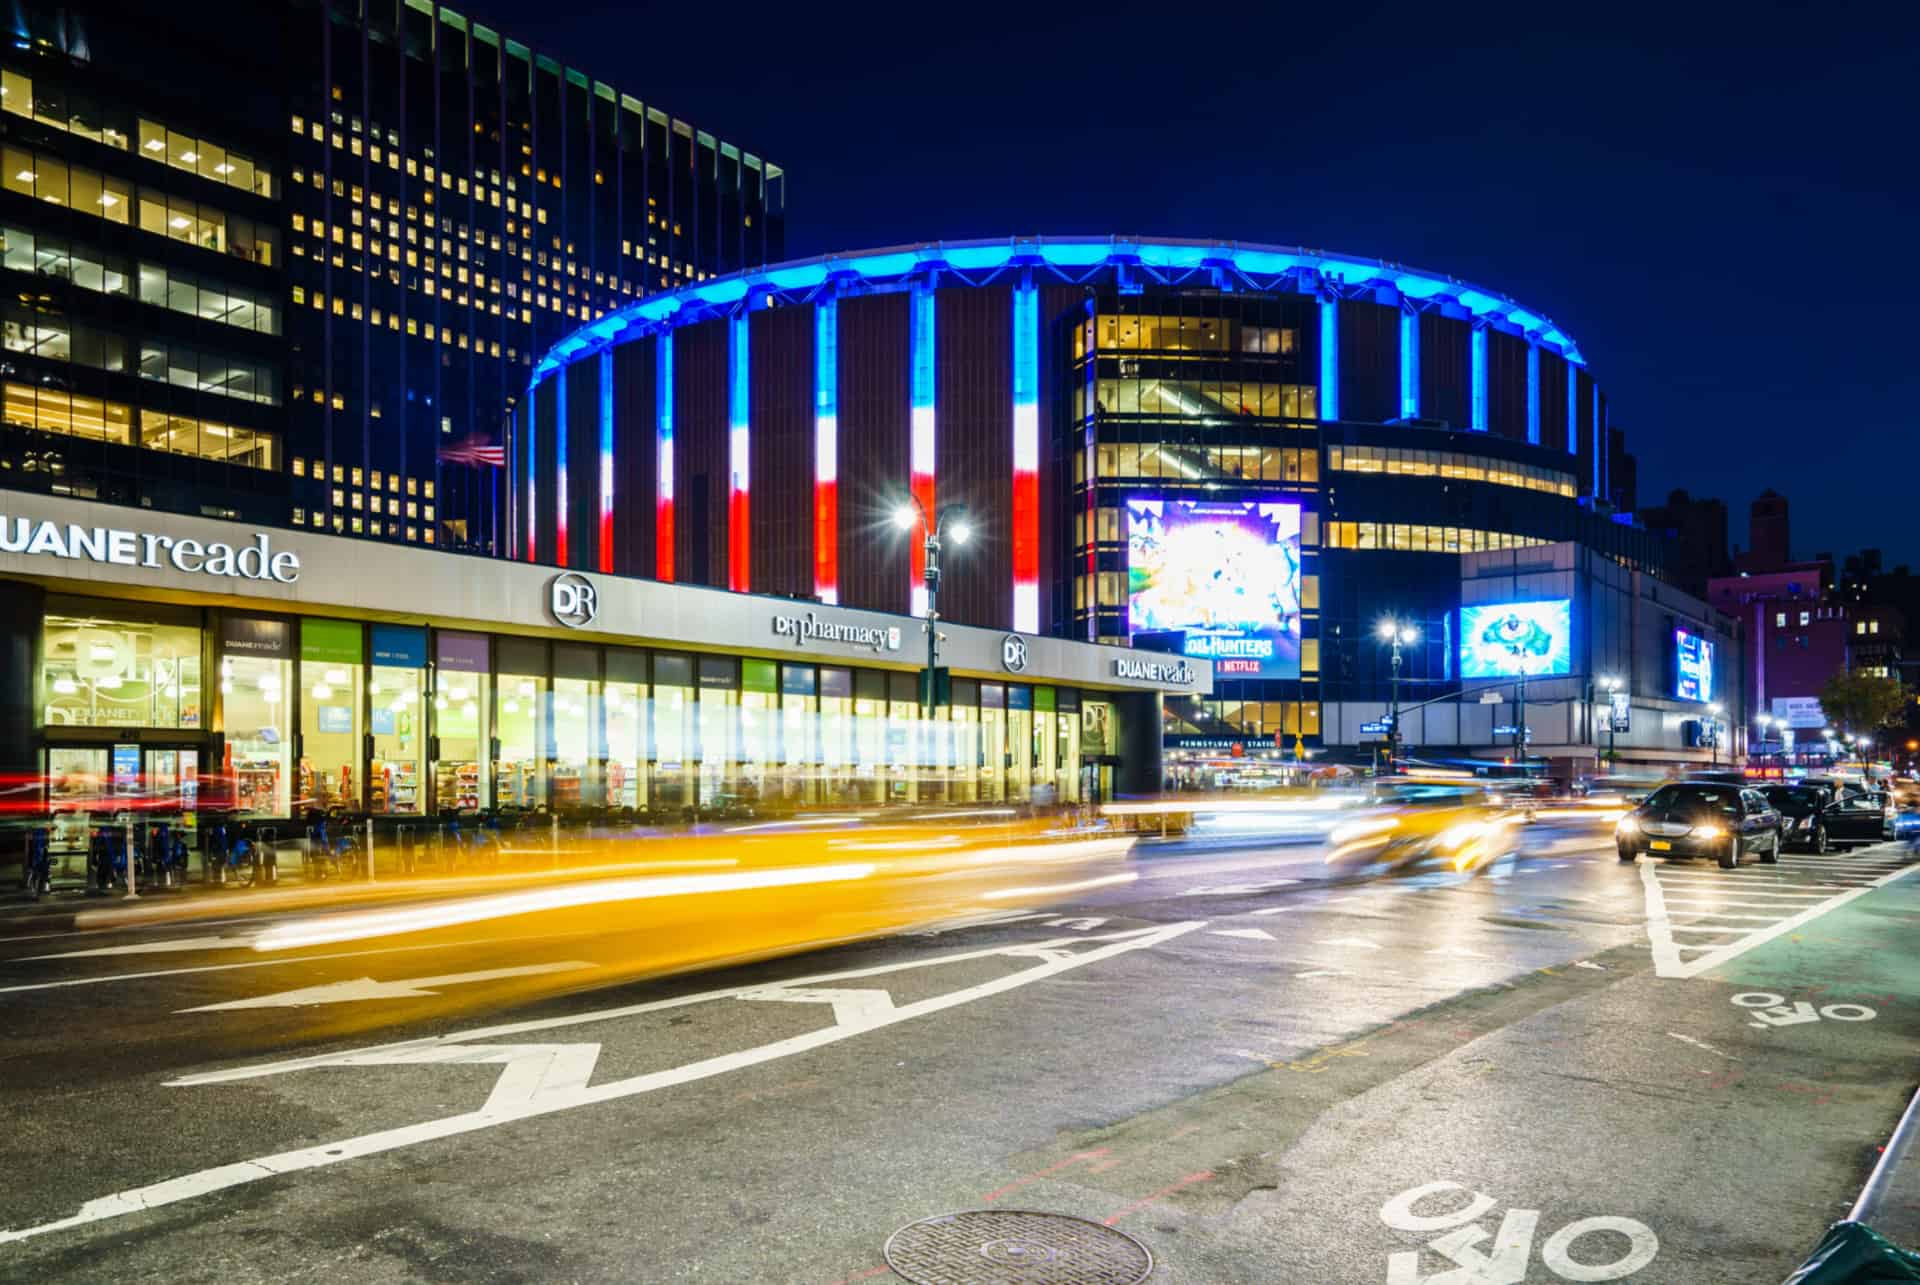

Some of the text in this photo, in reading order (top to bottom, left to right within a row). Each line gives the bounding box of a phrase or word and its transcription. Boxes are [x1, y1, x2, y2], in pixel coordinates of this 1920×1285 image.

[553, 583, 596, 616] DR
[1004, 643, 1026, 665] DR
[1224, 660, 1259, 672] NETFLIX
[1247, 740, 1276, 748] STATIO
